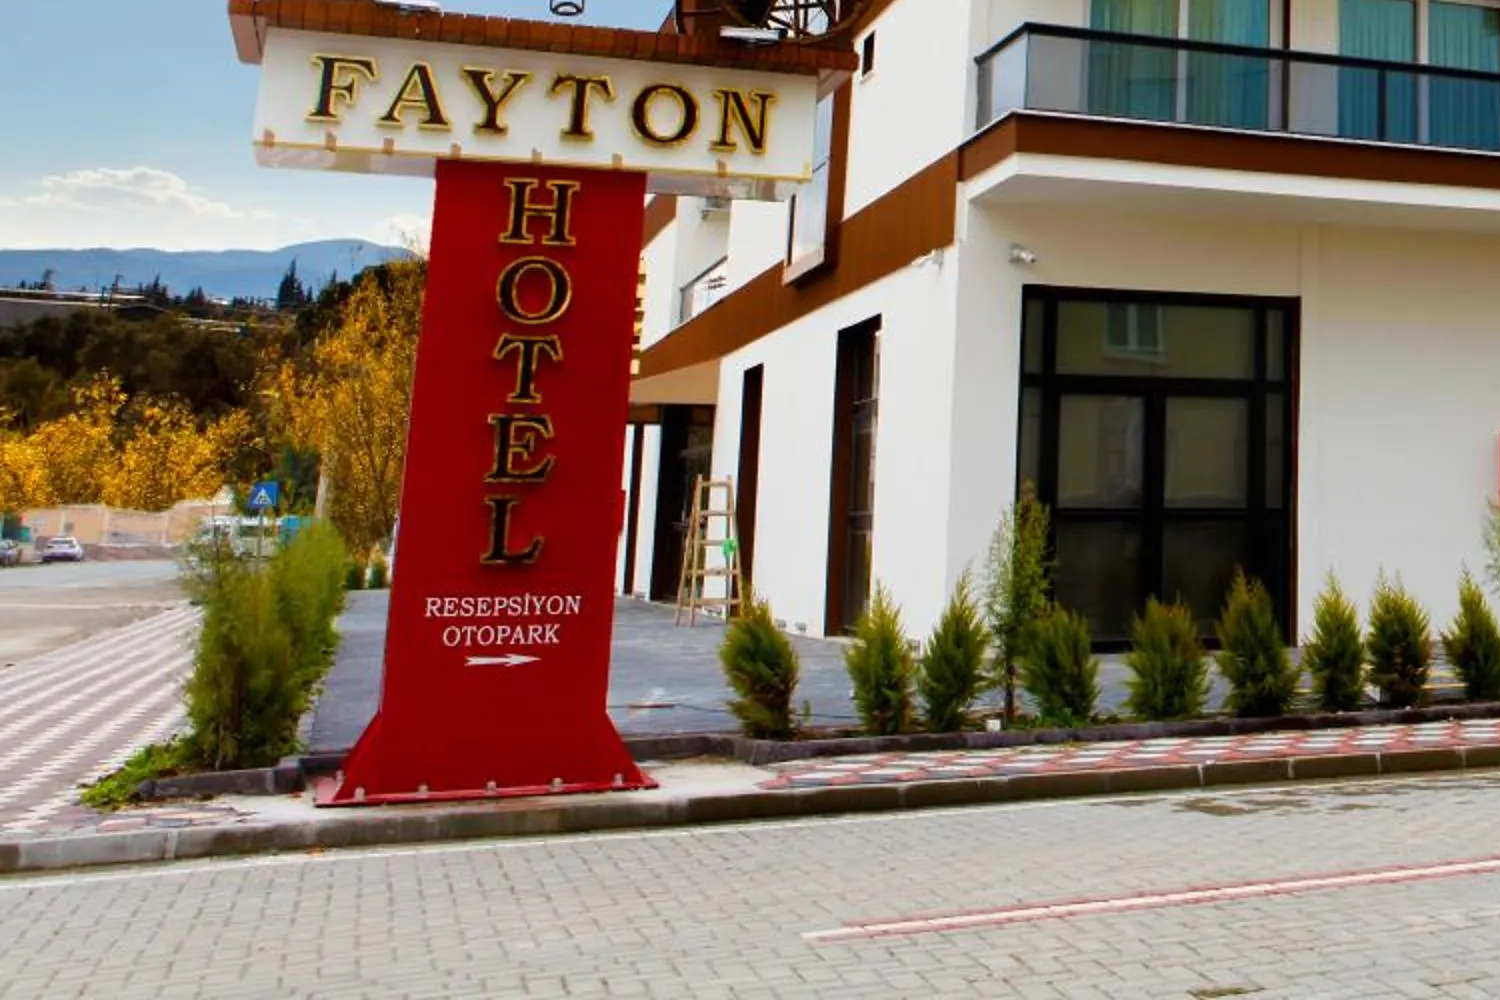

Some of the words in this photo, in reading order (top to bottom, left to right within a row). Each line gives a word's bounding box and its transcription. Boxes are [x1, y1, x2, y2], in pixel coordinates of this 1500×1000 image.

[305, 53, 778, 156] FAYTON
[479, 176, 582, 565] HOTEL
[424, 592, 582, 618] RESEPSİYON
[442, 623, 561, 647] OTOPARK
